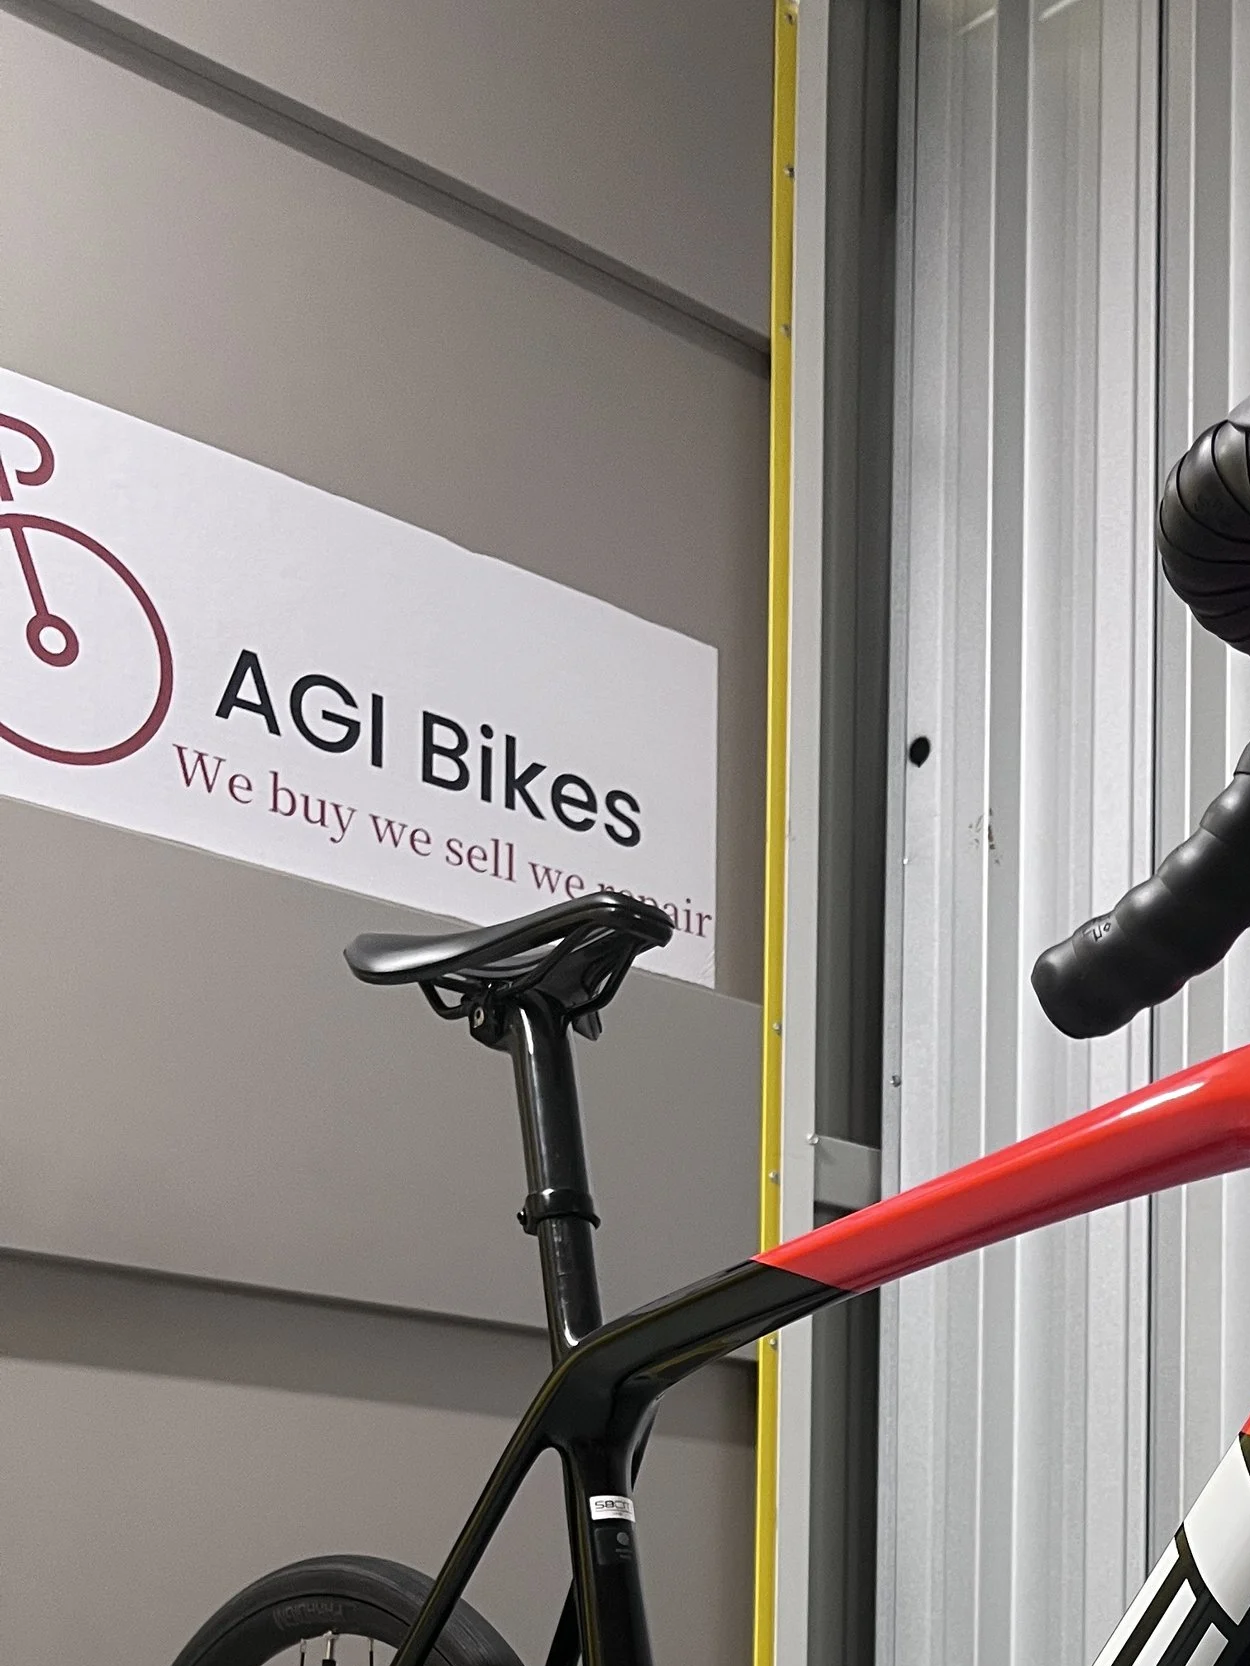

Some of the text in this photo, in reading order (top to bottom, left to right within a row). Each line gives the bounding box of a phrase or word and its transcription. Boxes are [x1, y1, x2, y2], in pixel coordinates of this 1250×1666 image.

[172, 743, 713, 938] We buy we sell we air
[214, 648, 643, 848] AGI Bikes
